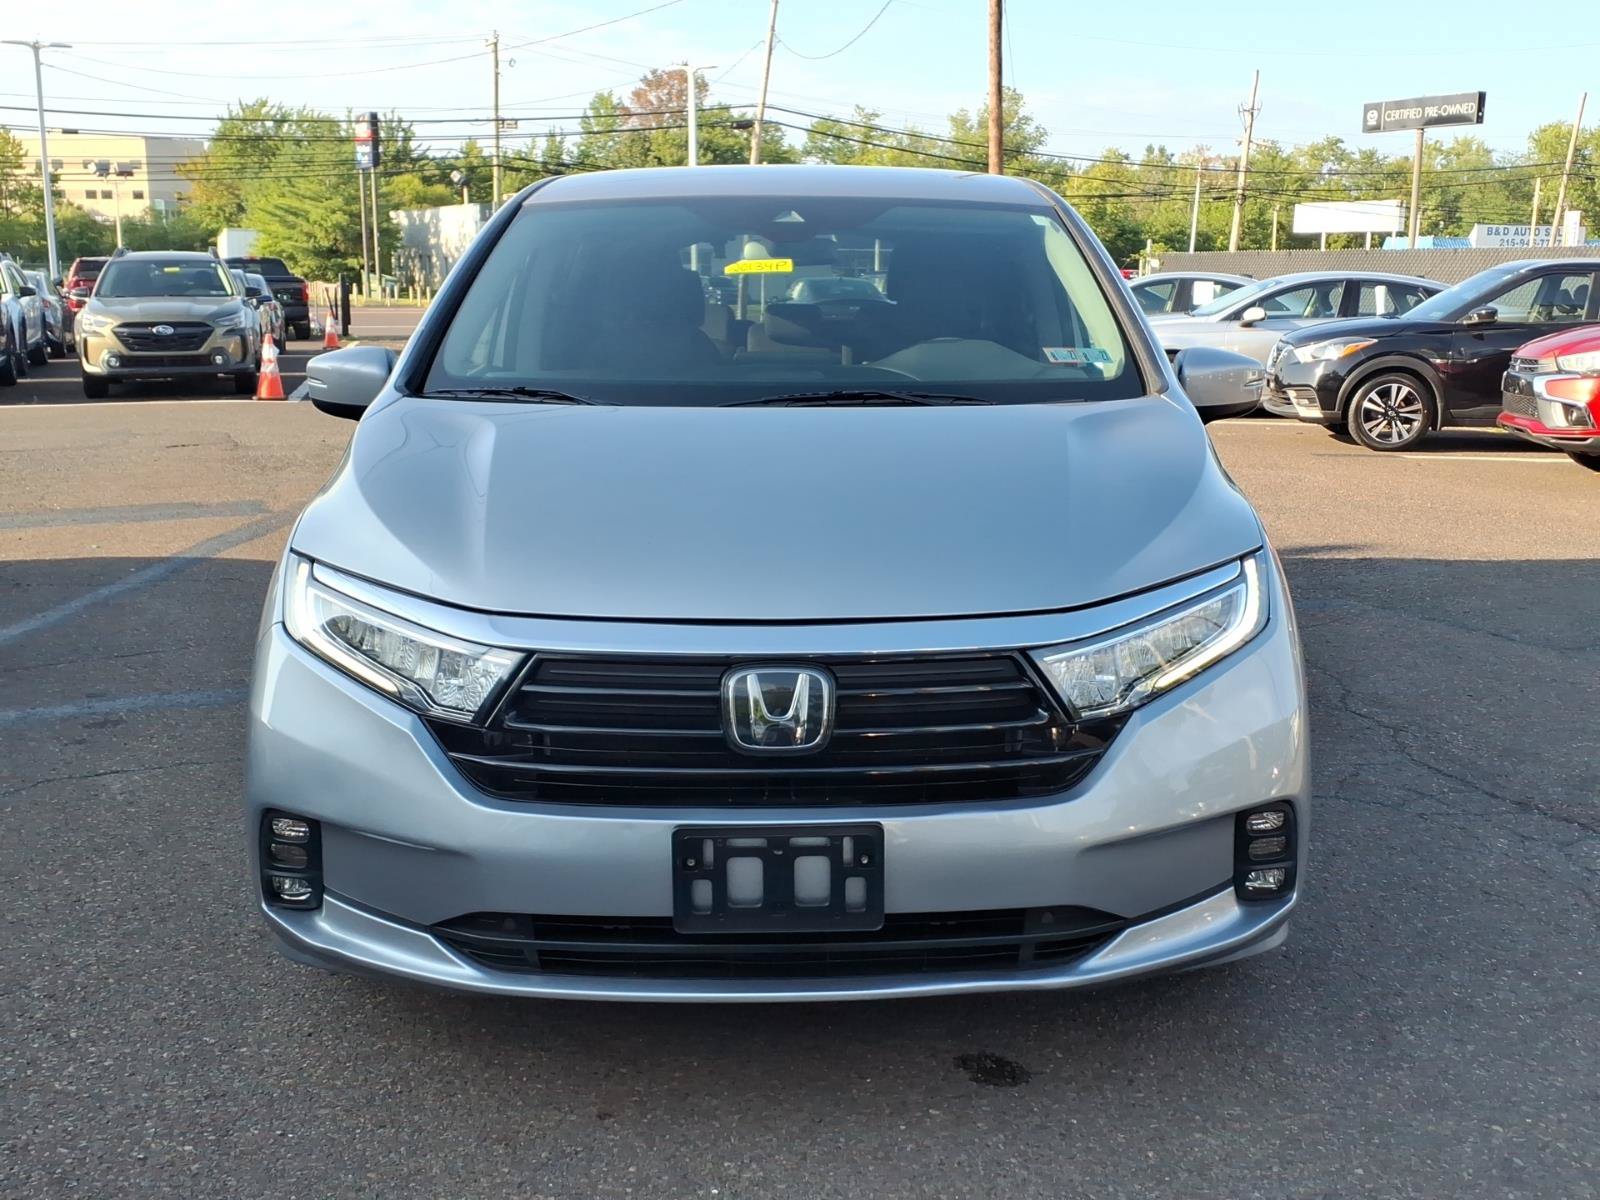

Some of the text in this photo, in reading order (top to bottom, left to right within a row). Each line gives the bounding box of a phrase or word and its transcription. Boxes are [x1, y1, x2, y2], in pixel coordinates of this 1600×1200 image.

[1385, 103, 1476, 121] CERTIFIED PRE-OWNED
[1487, 227, 1510, 236] B&D
